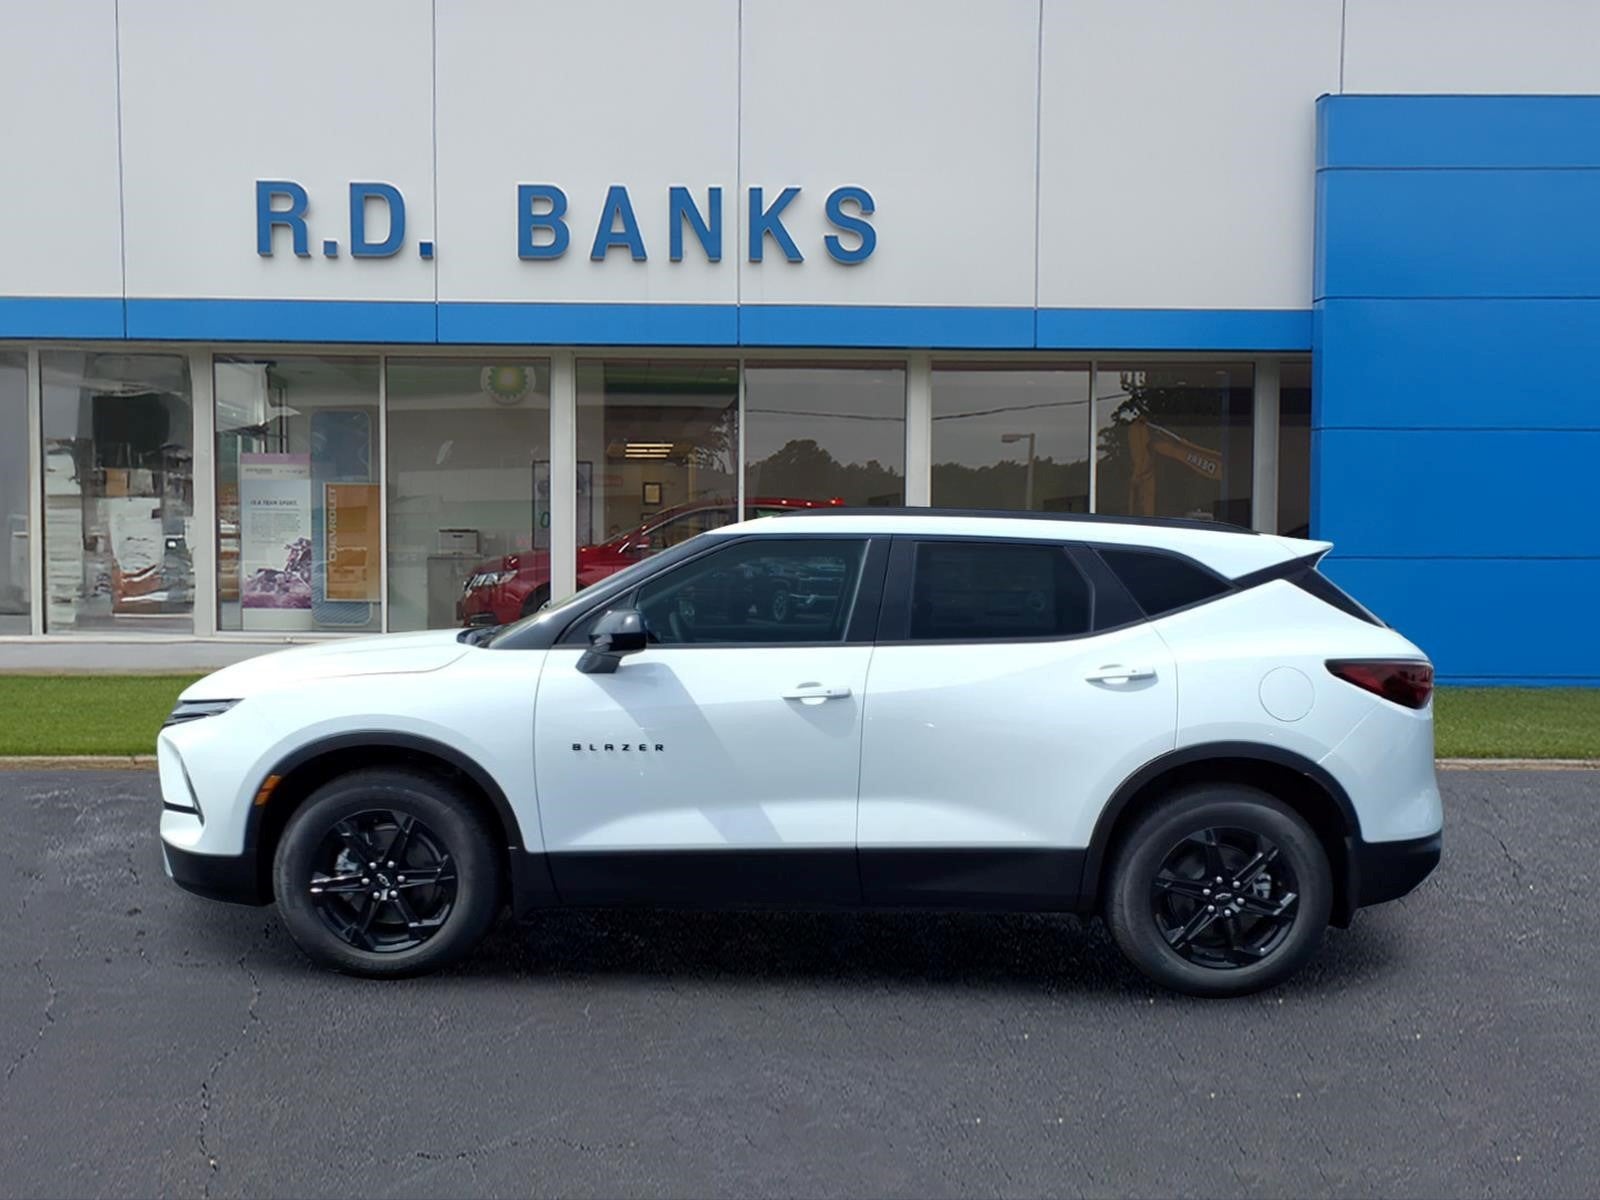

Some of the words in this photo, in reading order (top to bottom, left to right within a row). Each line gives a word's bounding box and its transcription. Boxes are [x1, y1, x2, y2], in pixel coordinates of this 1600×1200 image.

[256, 180, 434, 258] R.D.
[517, 184, 877, 264] BANKS
[328, 488, 336, 562] CHEVROLET
[571, 743, 665, 751] BLAZER
